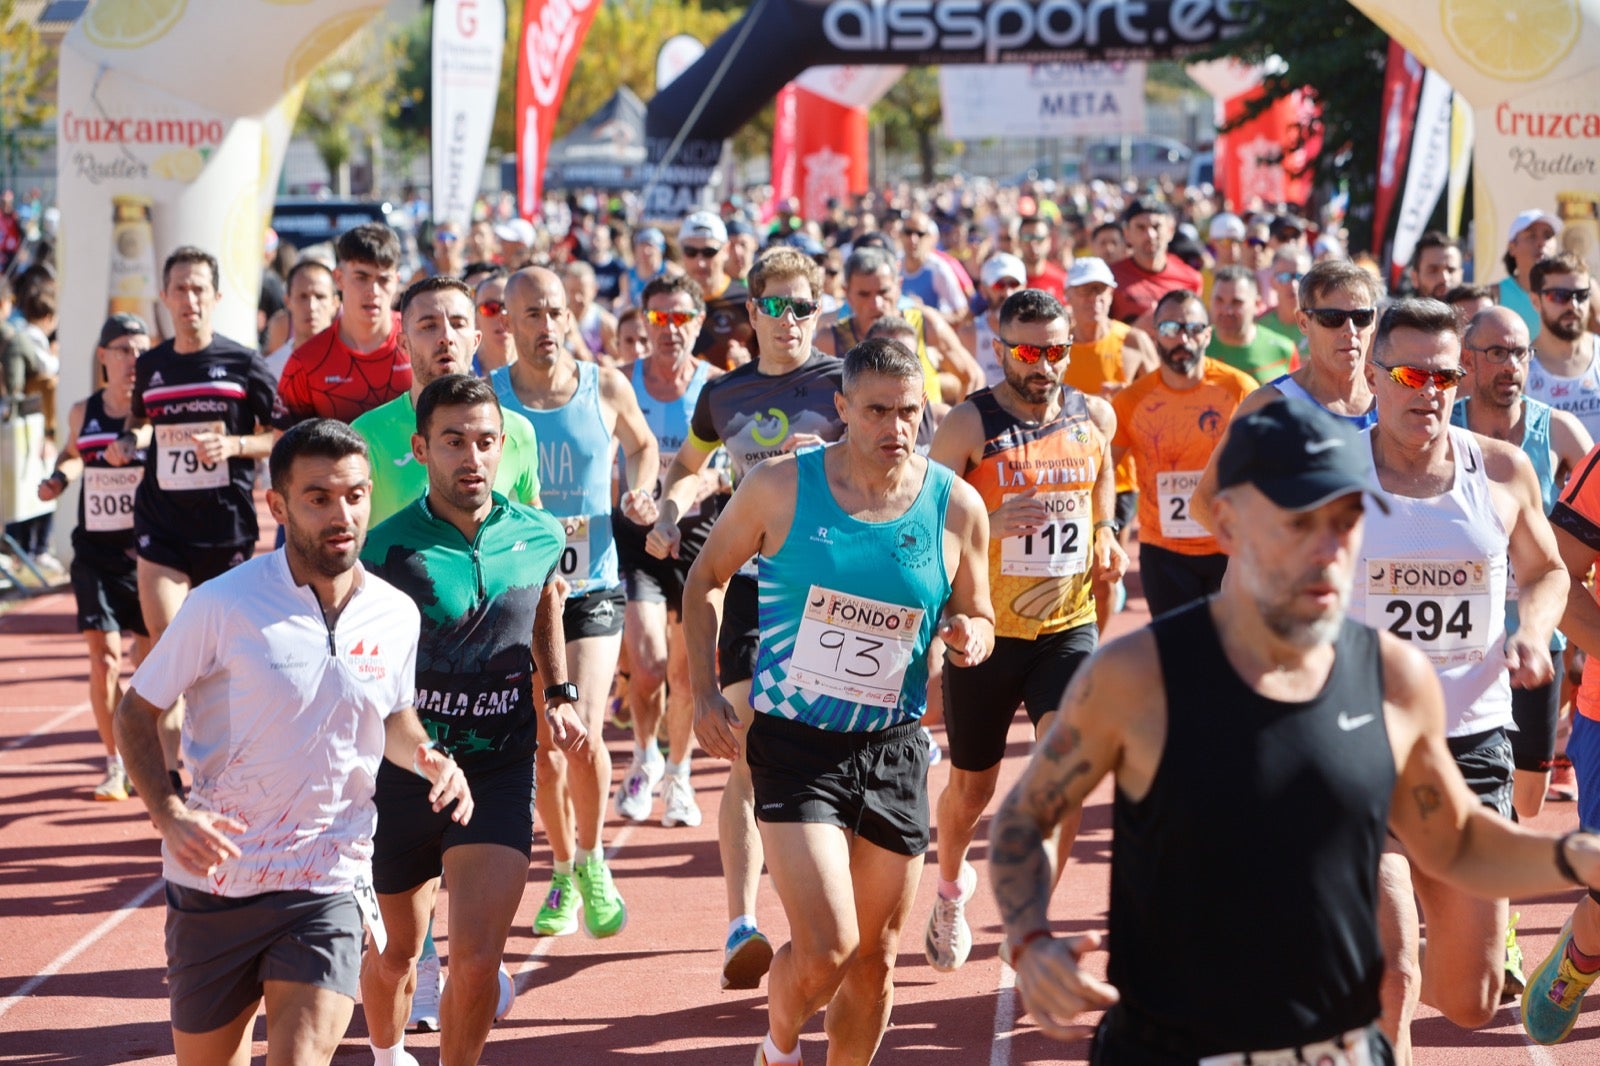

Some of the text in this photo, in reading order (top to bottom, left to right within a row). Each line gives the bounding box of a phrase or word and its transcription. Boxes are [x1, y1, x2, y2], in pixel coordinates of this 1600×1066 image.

[1039, 92, 1120, 117] META
[64, 110, 223, 148] Cruzcampo
[73, 152, 150, 185] Radler
[1509, 145, 1598, 180] Radler
[996, 461, 1026, 487] LA
[90, 494, 135, 516] 308
[1393, 568, 1468, 587] FONDO
[830, 600, 901, 631] FONDO
[1385, 599, 1473, 642] 294
[819, 629, 885, 678] 93
